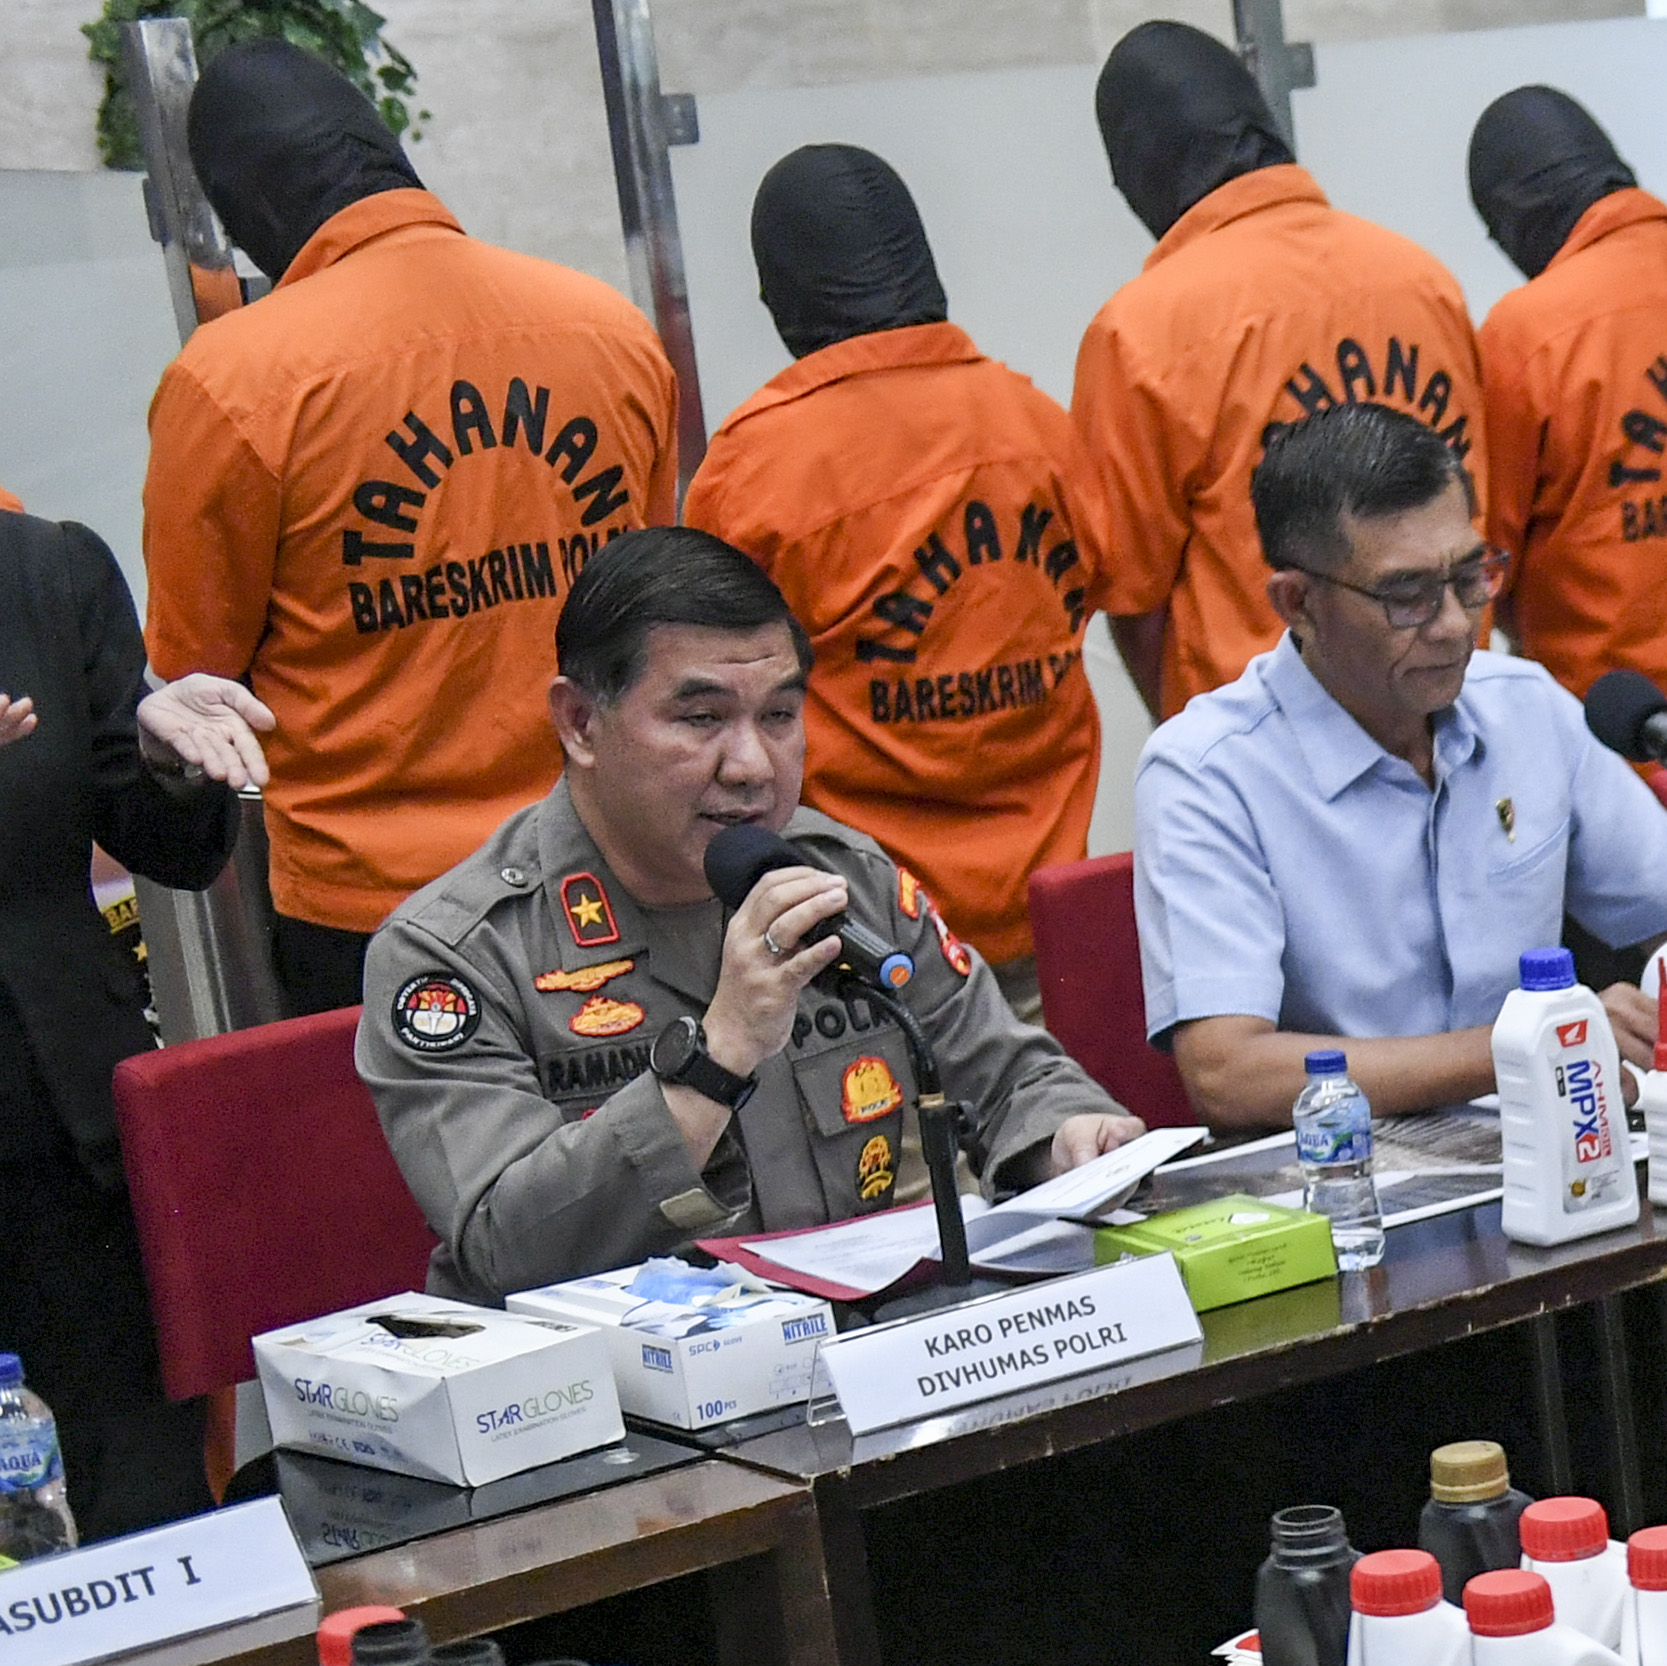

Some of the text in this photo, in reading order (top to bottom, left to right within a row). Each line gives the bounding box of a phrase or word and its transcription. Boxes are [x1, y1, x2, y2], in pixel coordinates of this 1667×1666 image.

[342, 377, 630, 566] TAHANAN
[348, 542, 557, 634] BARESKRIM
[870, 658, 1049, 723] BARESKRIM
[1566, 1060, 1601, 1163] MPX2
[782, 1317, 828, 1342] NITRILE
[924, 1296, 1097, 1360] KARO PENMAS
[642, 1349, 672, 1370] NITRILE
[918, 1323, 1128, 1399] DIVHUMAS POLRI
[295, 1378, 398, 1423] STAR GLOVES
[477, 1380, 594, 1434] STAR GLOVES
[696, 1400, 723, 1421] 100
[178, 1556, 201, 1586] I
